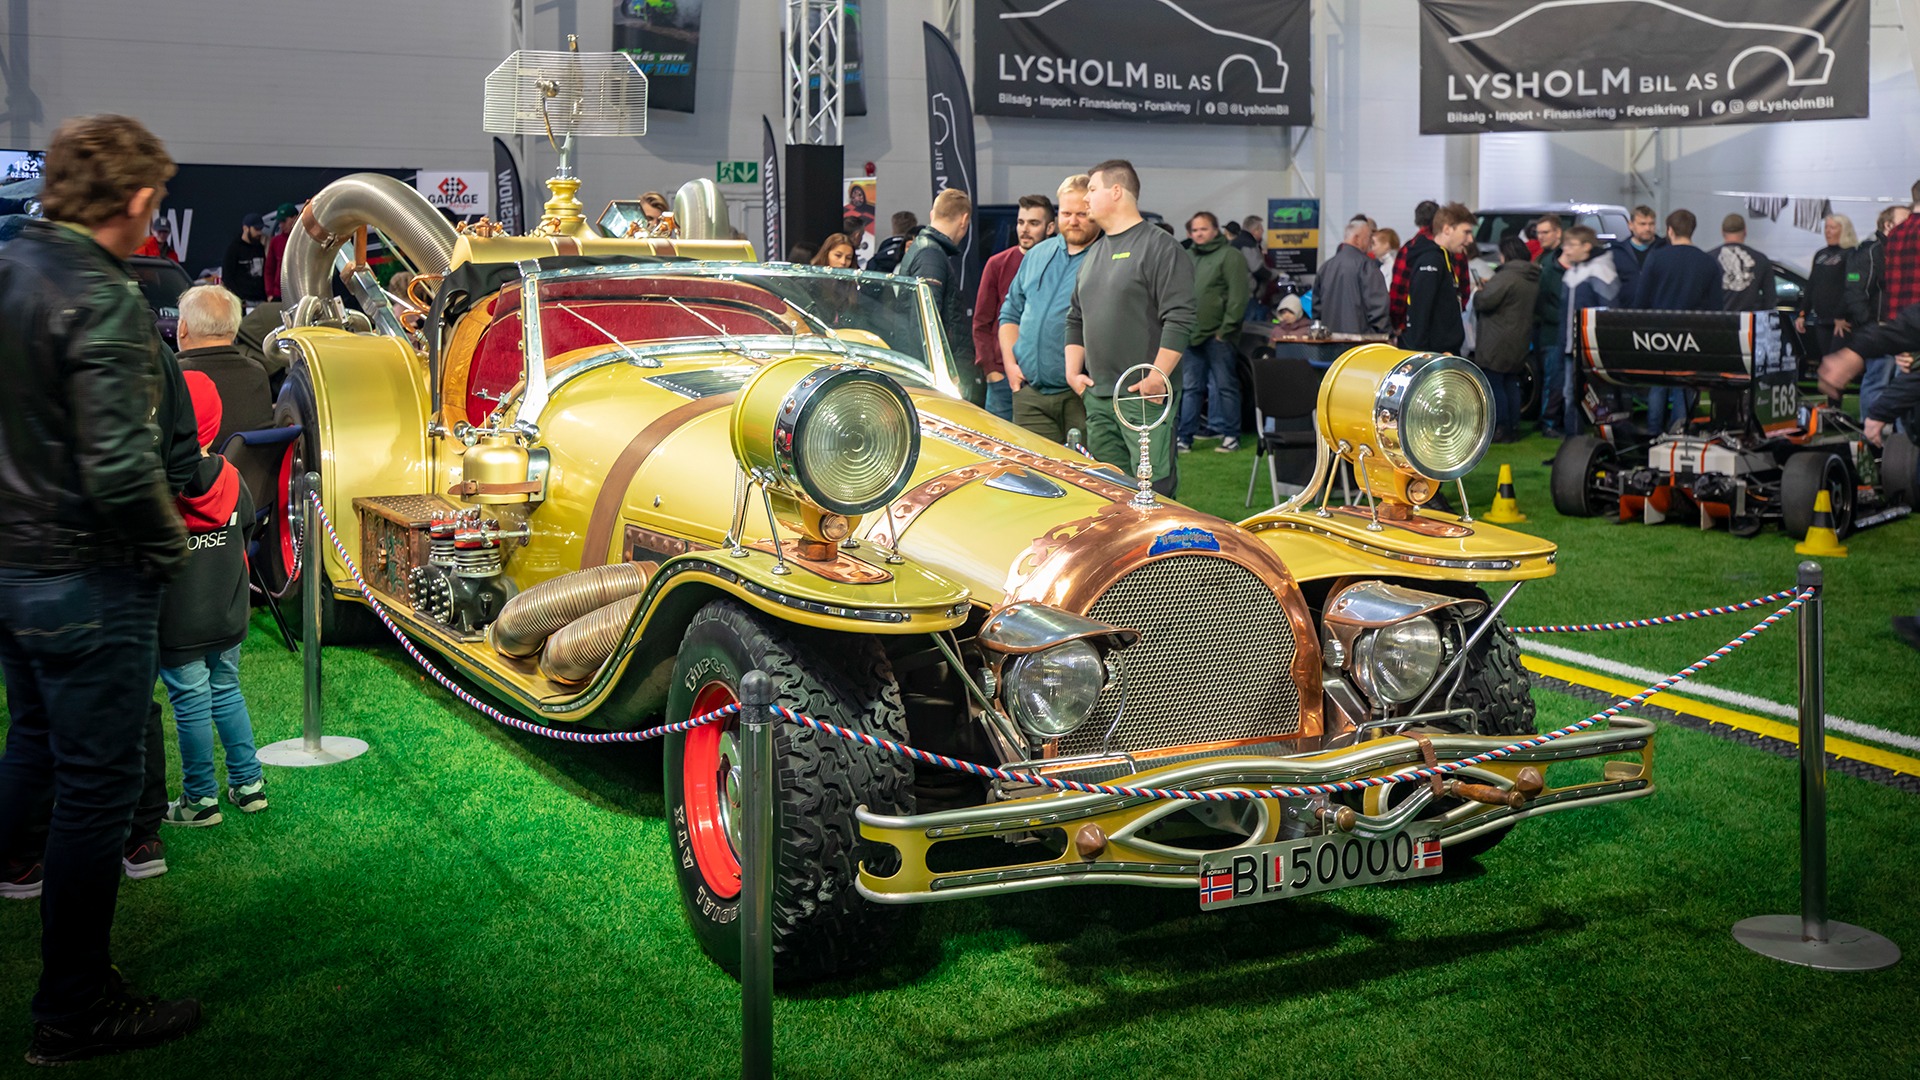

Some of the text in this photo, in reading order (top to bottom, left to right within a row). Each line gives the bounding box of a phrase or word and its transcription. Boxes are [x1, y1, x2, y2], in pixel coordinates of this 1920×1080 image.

[999, 53, 1212, 91] LYSHOLM BIL AS
[1448, 67, 1718, 100] LYSHOLM BIL AS
[998, 93, 1290, 116] Bilsalg Import Finansiering Forsikring @LysholmBil
[1447, 96, 1834, 124] Bilsalg Import Finansiering Forsikring @LysholmBil
[14, 160, 39, 171] 162
[934, 149, 944, 171] BIL
[428, 194, 479, 204] GARAGE
[1632, 330, 1700, 352] NOVA
[1771, 383, 1796, 418] E63
[186, 531, 228, 550] ORSE
[674, 804, 694, 869] ATX
[696, 886, 740, 924] ADIAL
